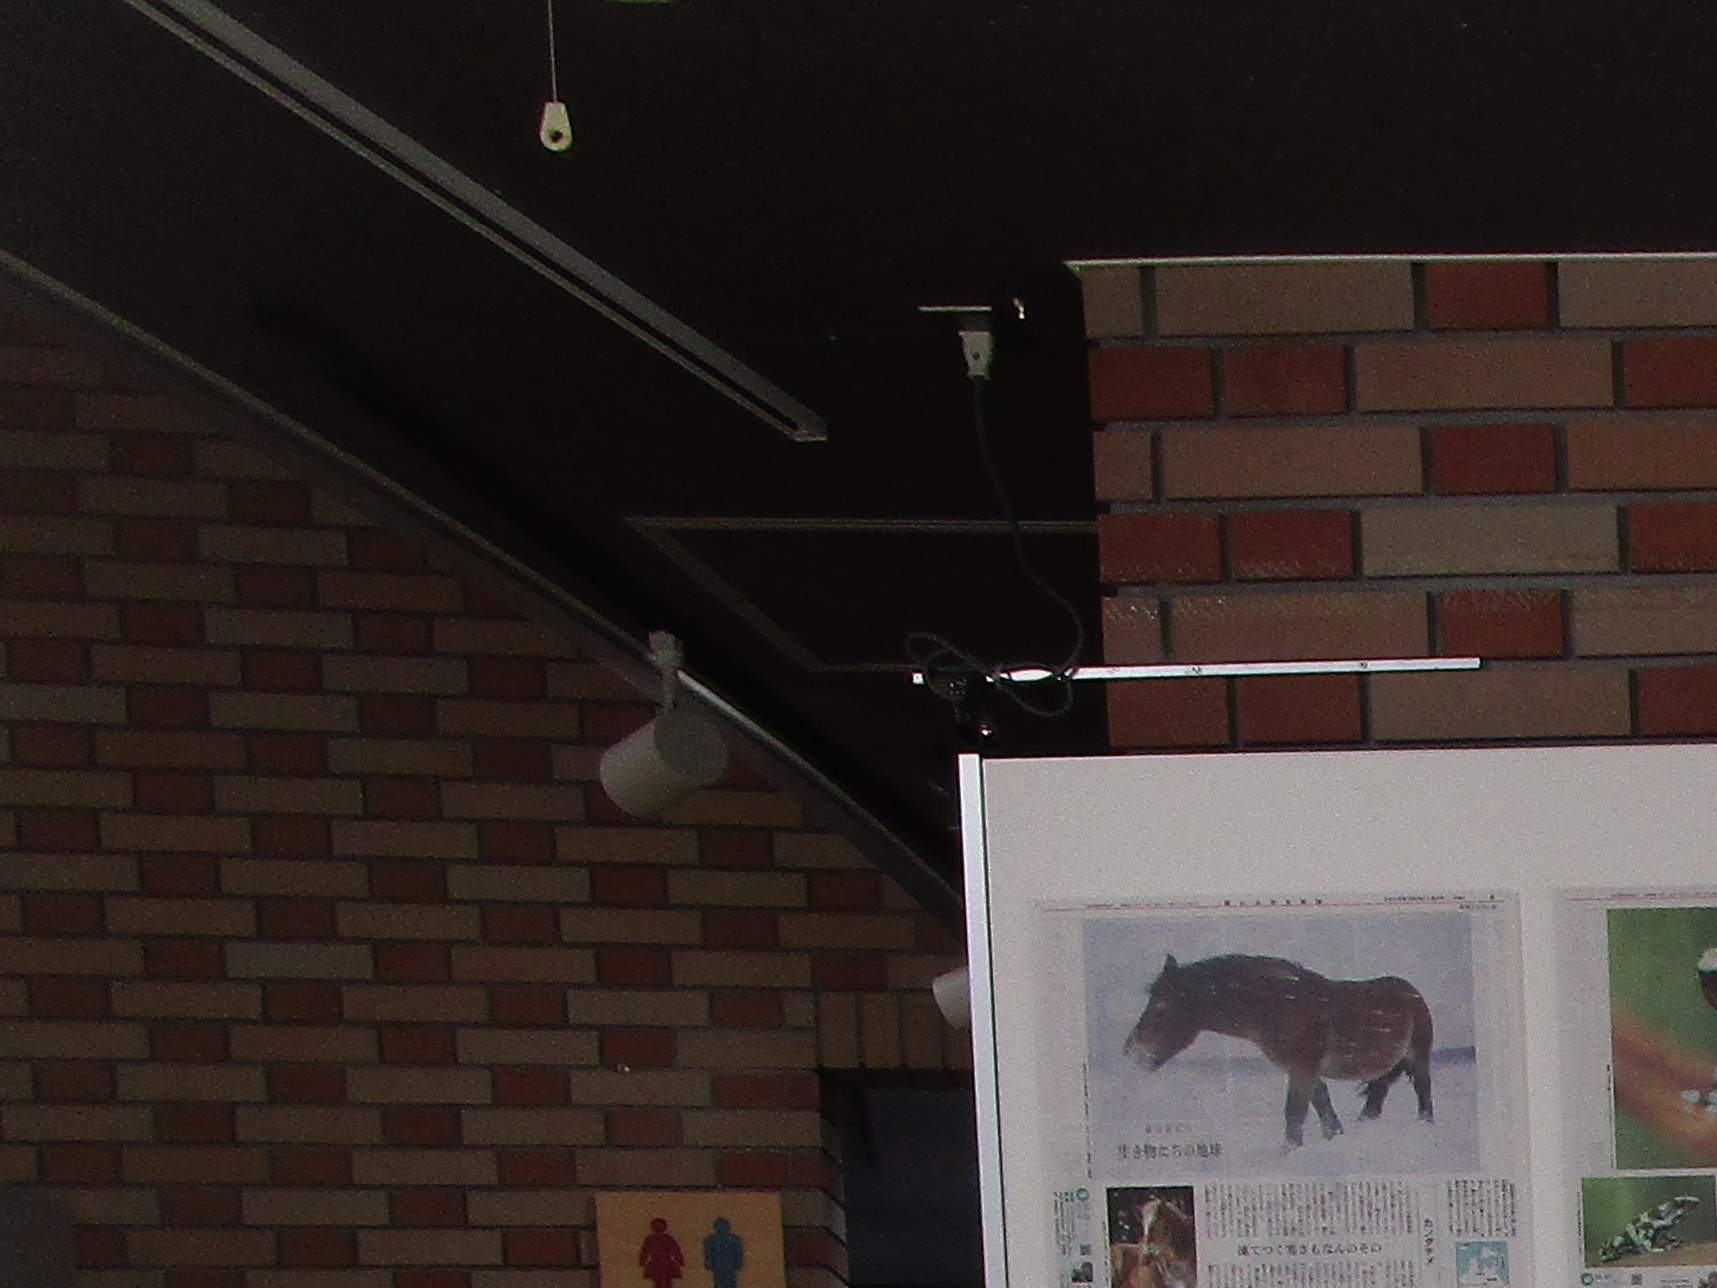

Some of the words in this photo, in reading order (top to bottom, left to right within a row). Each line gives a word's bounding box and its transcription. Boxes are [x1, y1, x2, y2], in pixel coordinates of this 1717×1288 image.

[1118, 1142, 1222, 1159] 生き物たちの地球
